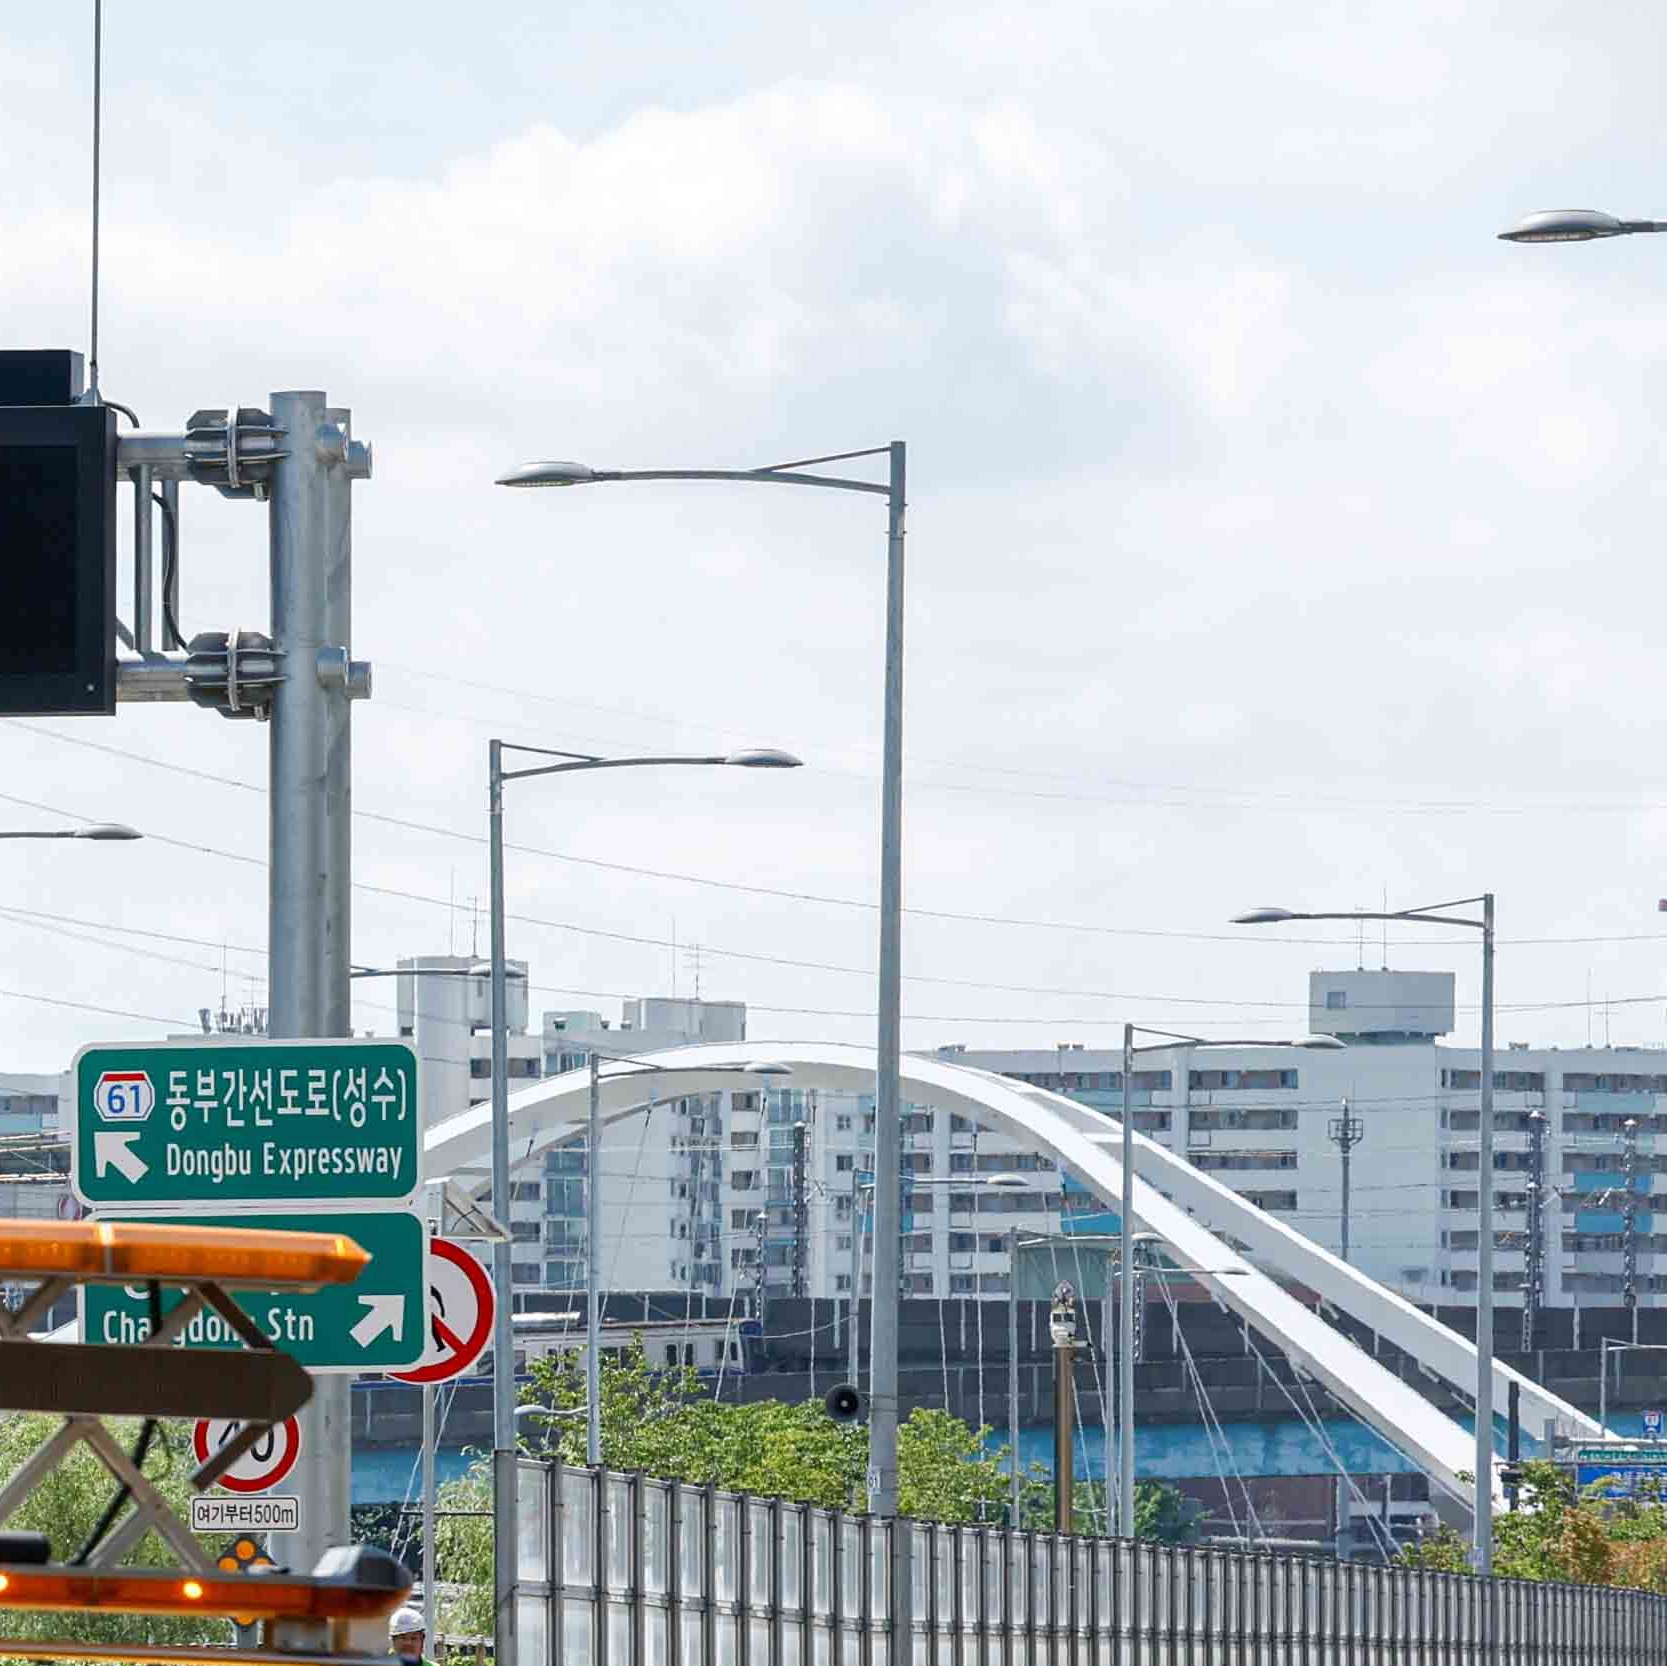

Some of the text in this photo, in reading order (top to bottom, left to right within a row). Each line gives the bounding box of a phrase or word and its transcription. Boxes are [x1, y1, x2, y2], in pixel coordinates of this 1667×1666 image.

[107, 1083, 144, 1115] 61
[165, 1066, 407, 1132] 동부간선도로(성수)
[166, 1141, 404, 1184] Dongbu Expressway
[267, 1306, 315, 1342] Stn
